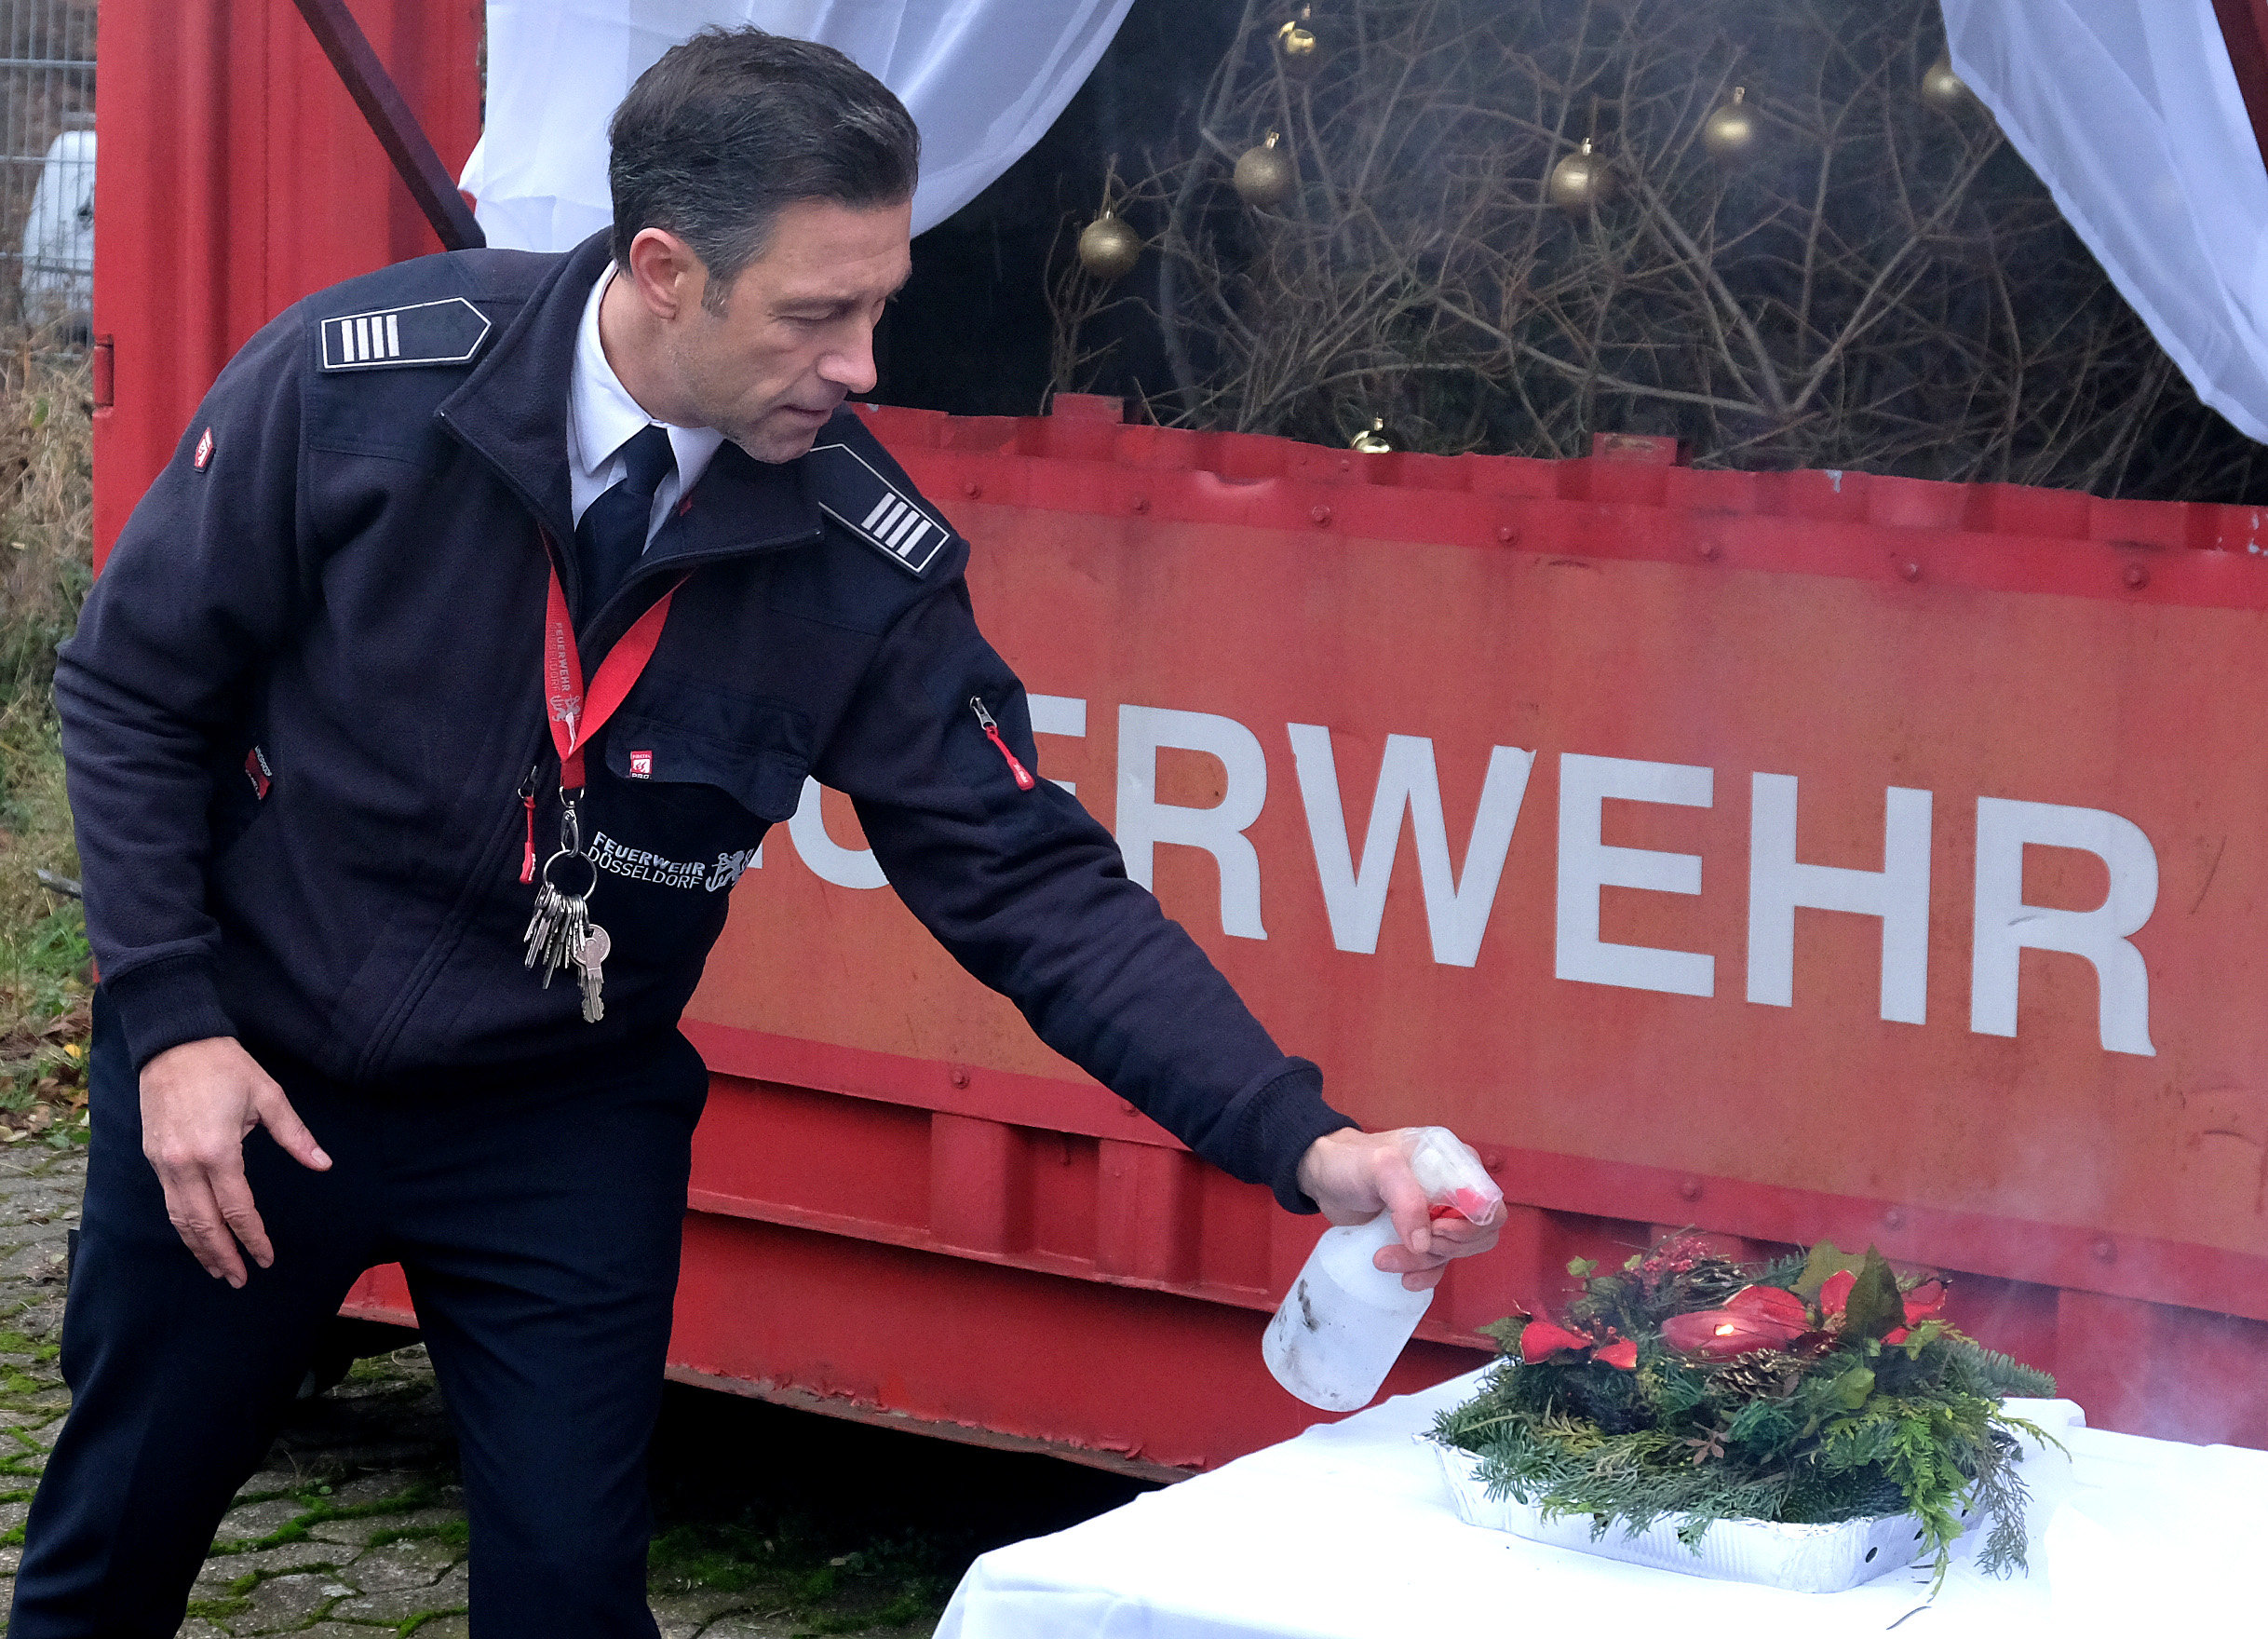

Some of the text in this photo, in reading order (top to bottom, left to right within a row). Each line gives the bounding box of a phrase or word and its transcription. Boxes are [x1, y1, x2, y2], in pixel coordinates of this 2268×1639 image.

[556, 622, 571, 692] FEUERWEHR
[587, 846, 703, 889] DÜSSELDORF
[592, 831, 706, 876] FEUERWEHR
